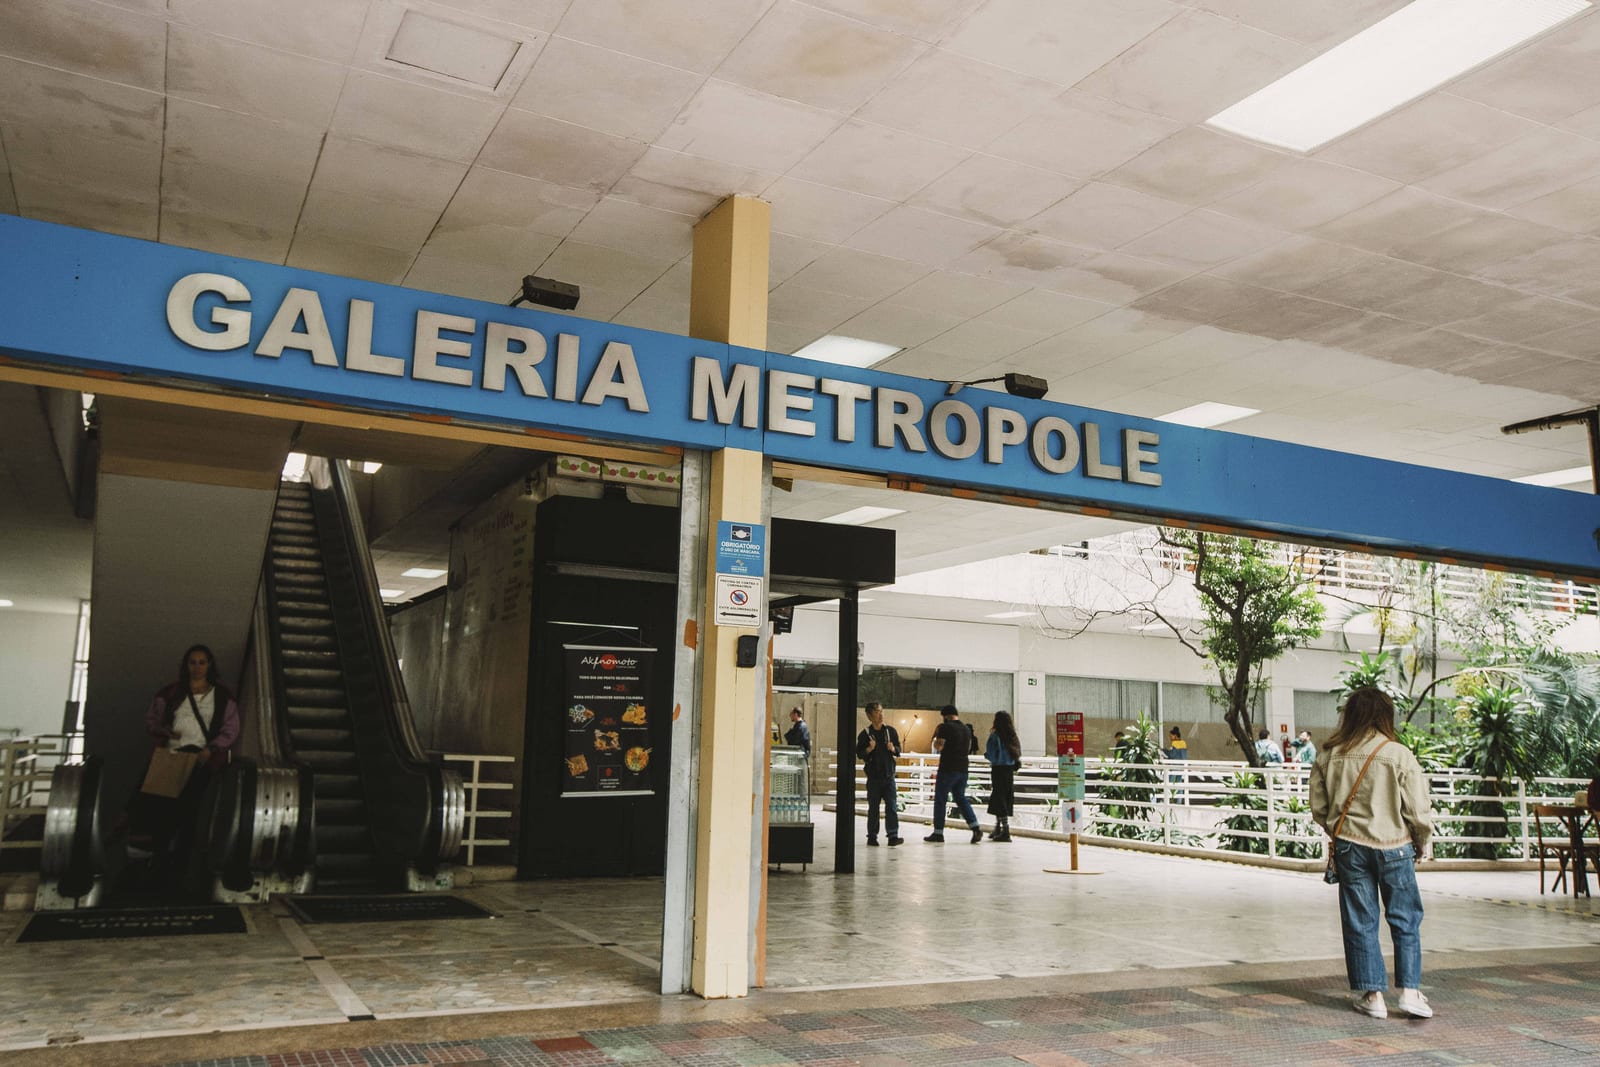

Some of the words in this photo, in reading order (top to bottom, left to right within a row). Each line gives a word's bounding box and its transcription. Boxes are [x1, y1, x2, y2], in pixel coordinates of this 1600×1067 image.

[166, 272, 650, 414] GALERIA
[721, 541, 760, 550] OBRIGATÓRIO
[1068, 807, 1076, 823] 1
